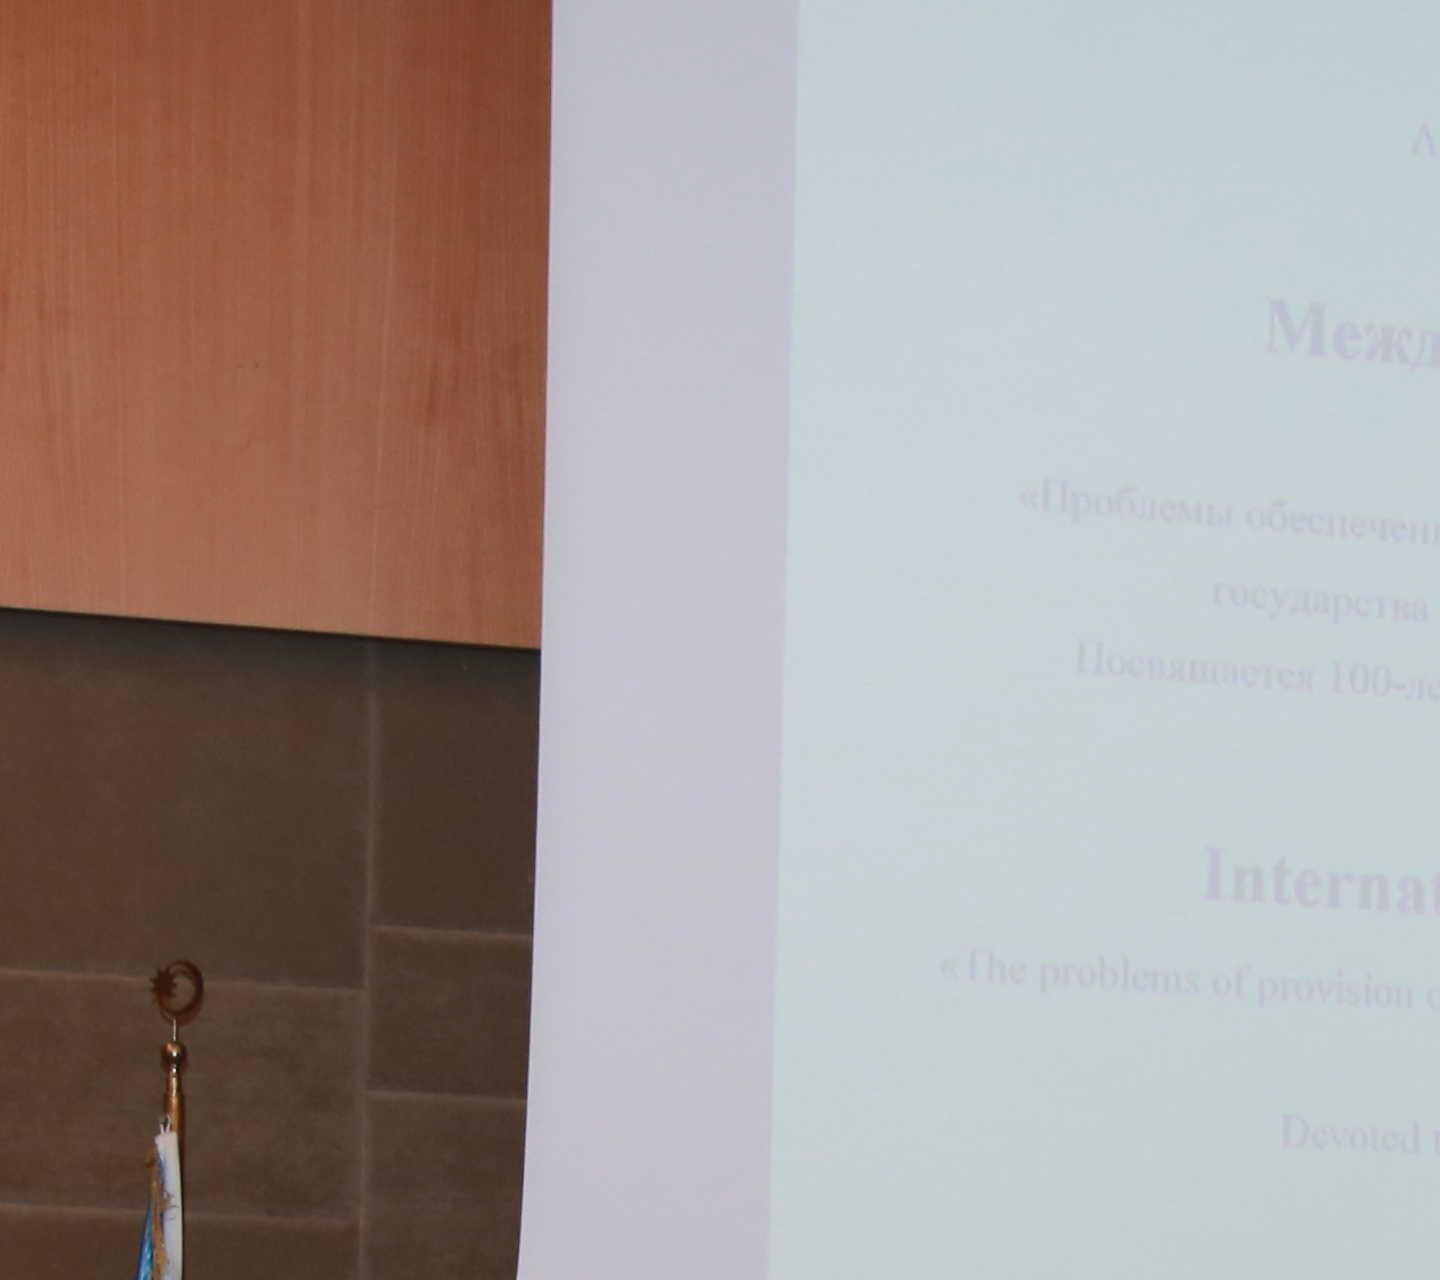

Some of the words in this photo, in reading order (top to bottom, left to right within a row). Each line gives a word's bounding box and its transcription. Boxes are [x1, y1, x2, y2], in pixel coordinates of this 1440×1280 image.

[1211, 582, 1431, 627] государства
[1075, 638, 1315, 694] Посвящается
[1038, 954, 1201, 997] problems
[1210, 963, 1251, 1001] of
[1257, 969, 1416, 1012] provision
[1280, 1112, 1422, 1156] Devoted
